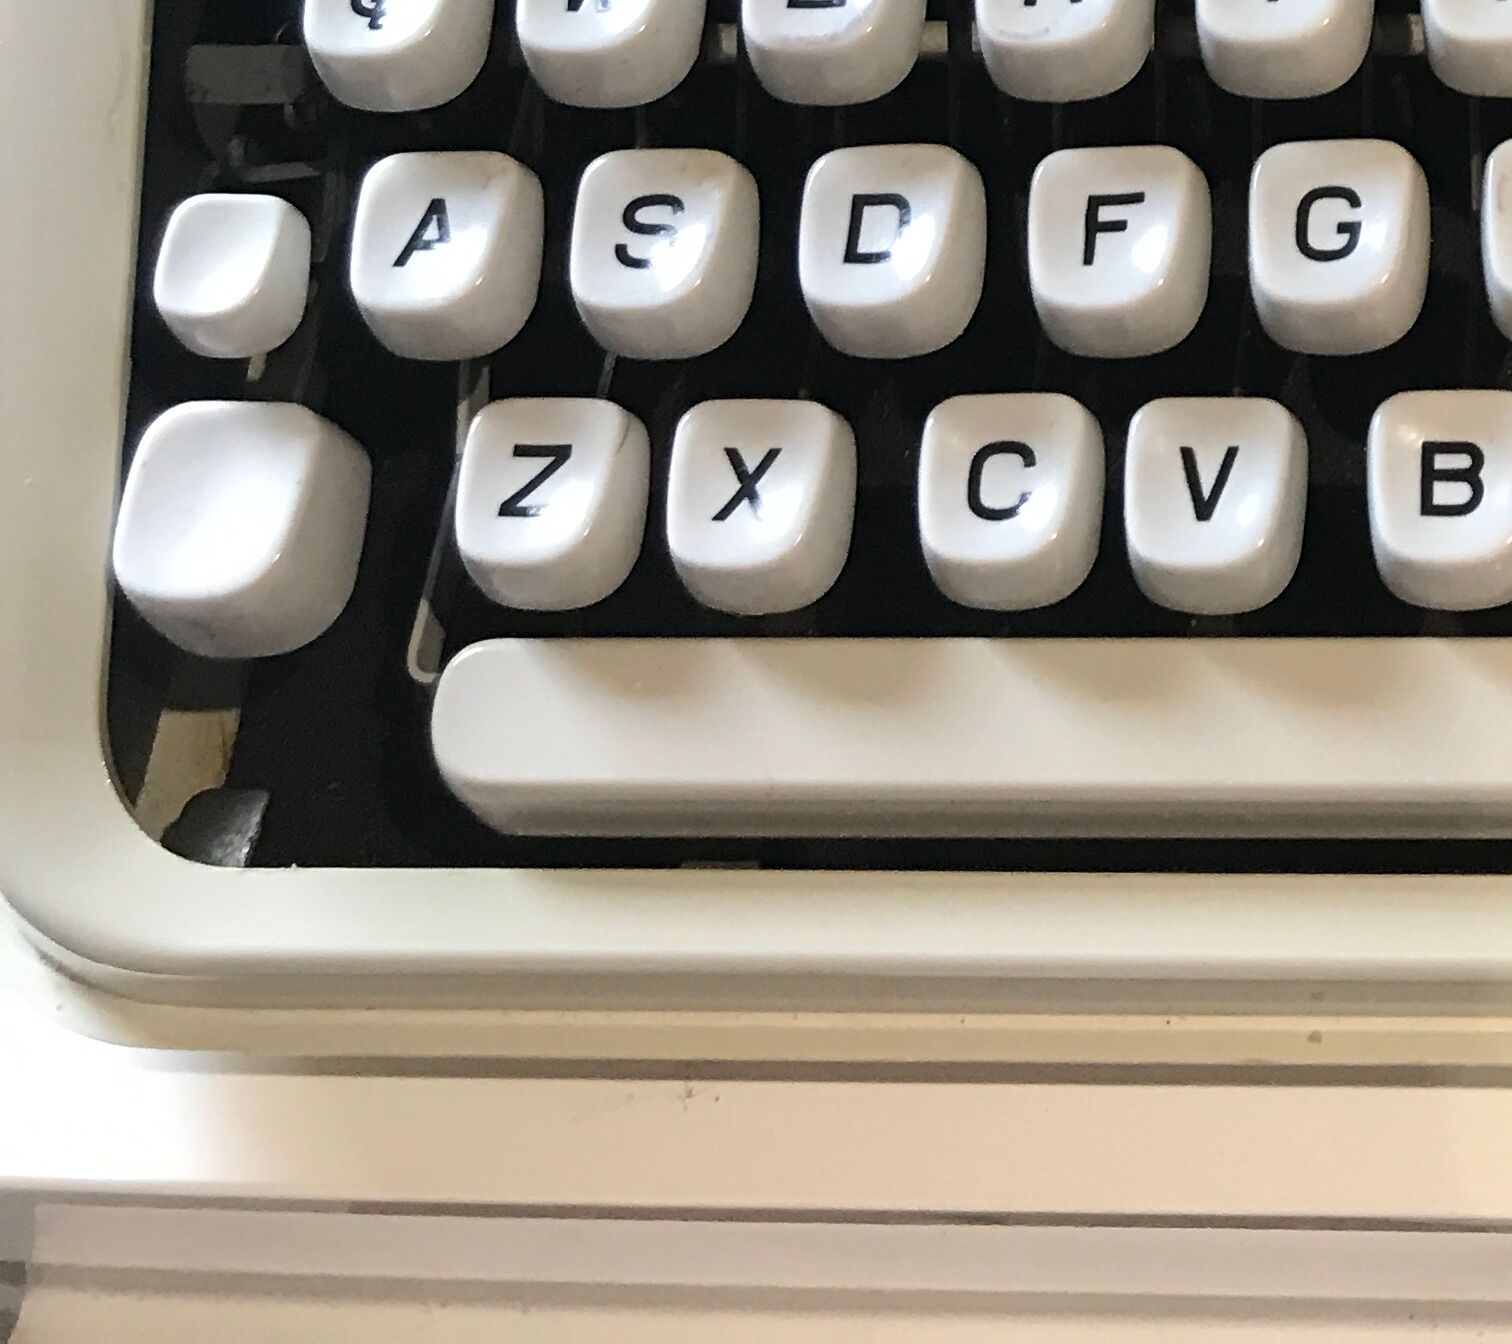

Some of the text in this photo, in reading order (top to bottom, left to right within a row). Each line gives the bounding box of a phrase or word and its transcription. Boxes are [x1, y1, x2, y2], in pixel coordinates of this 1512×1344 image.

[392, 197, 452, 267] A
[614, 193, 685, 269] S
[842, 192, 910, 265] D
[1082, 191, 1146, 266] F
[1294, 185, 1362, 263] G
[497, 443, 573, 518] Z
[711, 446, 783, 522] X
[967, 440, 1036, 522] C
[1179, 445, 1239, 522] V
[1420, 440, 1485, 517] B
